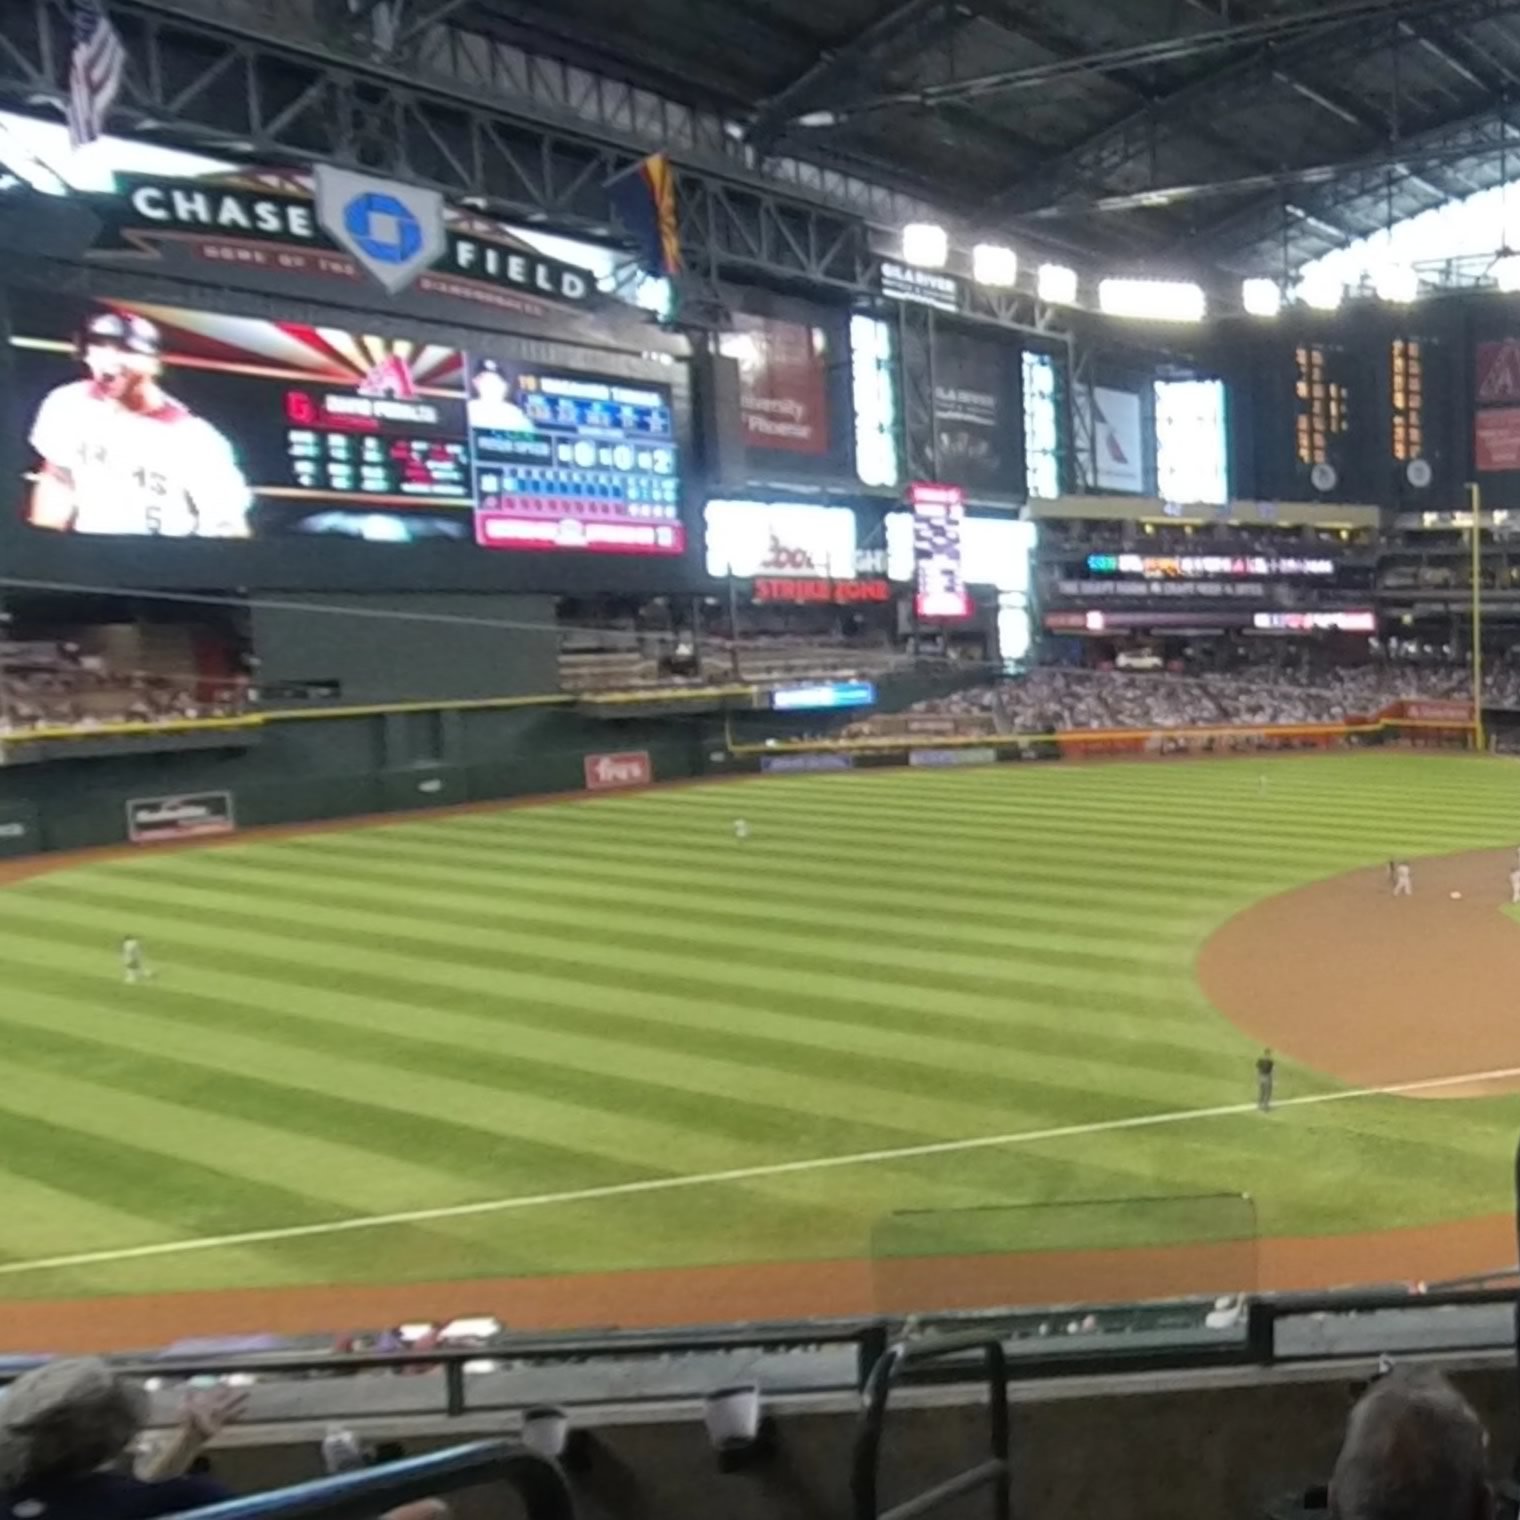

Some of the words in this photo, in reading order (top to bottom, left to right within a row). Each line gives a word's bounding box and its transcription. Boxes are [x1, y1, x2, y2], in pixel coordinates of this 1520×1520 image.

[131, 186, 314, 238] CHASE
[456, 240, 586, 299] FIELD
[203, 244, 268, 264] HOME
[881, 262, 915, 284] GILA
[916, 270, 956, 293] RIVER
[754, 578, 831, 602] STRIKE
[834, 579, 890, 602] ZONE
